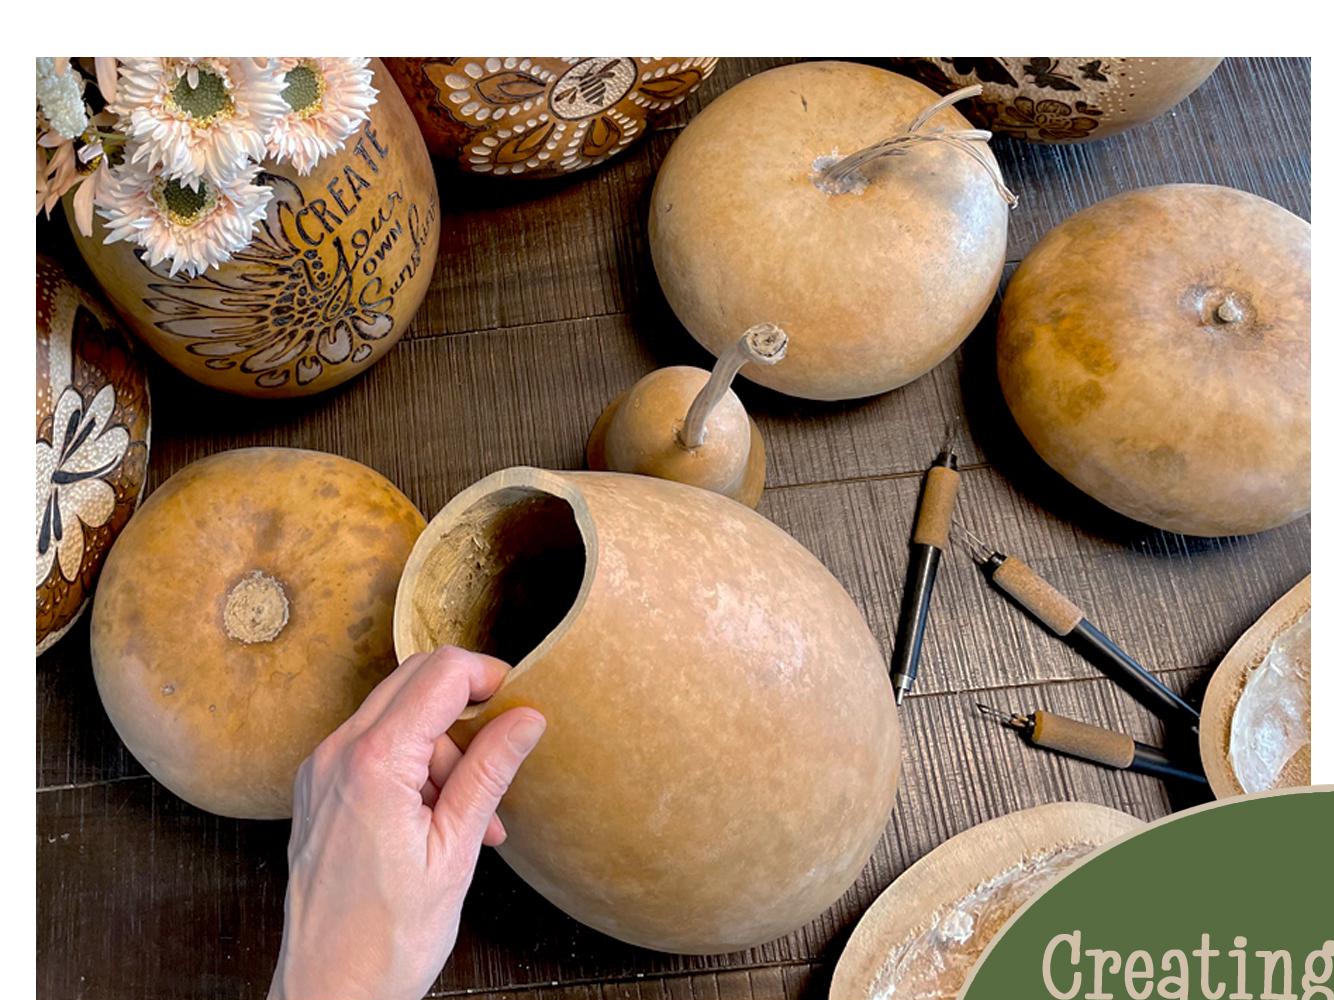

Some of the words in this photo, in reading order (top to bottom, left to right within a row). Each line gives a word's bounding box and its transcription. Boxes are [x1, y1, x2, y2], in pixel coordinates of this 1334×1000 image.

[295, 119, 389, 246] CREATE
[293, 182, 403, 322] Your
[362, 219, 402, 277] OWN
